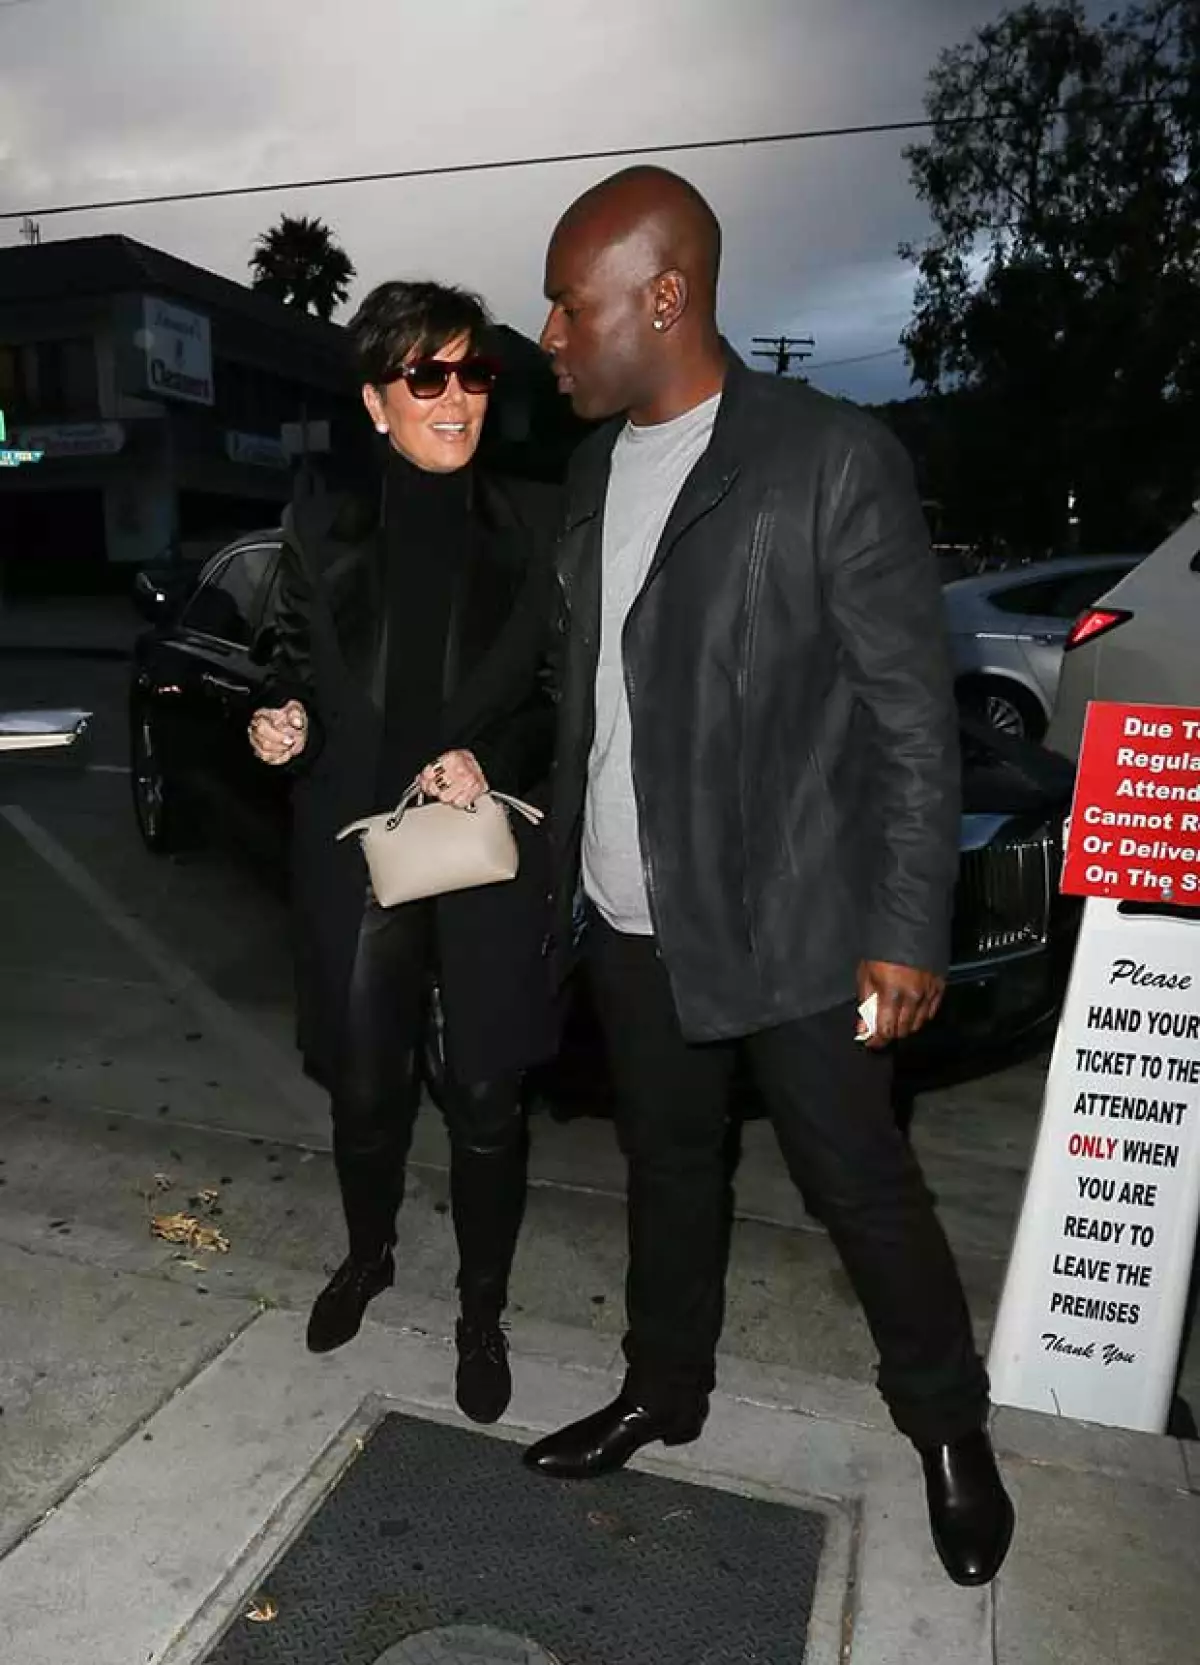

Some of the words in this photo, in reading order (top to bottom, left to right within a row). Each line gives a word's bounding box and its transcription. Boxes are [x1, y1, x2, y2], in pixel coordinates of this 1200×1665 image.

[1124, 716, 1173, 738] Due
[1182, 721, 1200, 740] T
[1084, 806, 1174, 830] Cannot
[1181, 814, 1200, 832] R
[1083, 836, 1113, 854] Or
[1085, 865, 1118, 884] On
[1127, 868, 1173, 888] The
[1180, 873, 1200, 891] S
[1109, 959, 1192, 990] Please
[1087, 1006, 1141, 1032] HAND
[1147, 1010, 1200, 1039] YOUR
[1076, 1049, 1137, 1076] TICKET
[1140, 1054, 1162, 1079] TO
[1167, 1058, 1200, 1084] THE
[1073, 1091, 1188, 1126] ATTENDANT
[1068, 1134, 1119, 1160] ONLY
[1122, 1139, 1180, 1168] WHEN
[1077, 1176, 1116, 1201] YOU
[1118, 1182, 1157, 1206] ARE
[1064, 1215, 1126, 1244] READY
[1130, 1225, 1155, 1248] TO
[1053, 1254, 1111, 1282] LEAVE
[1116, 1263, 1152, 1287] THE
[1050, 1292, 1141, 1325] PREMISES
[1041, 1333, 1096, 1359] Thank
[1101, 1343, 1136, 1366] You
